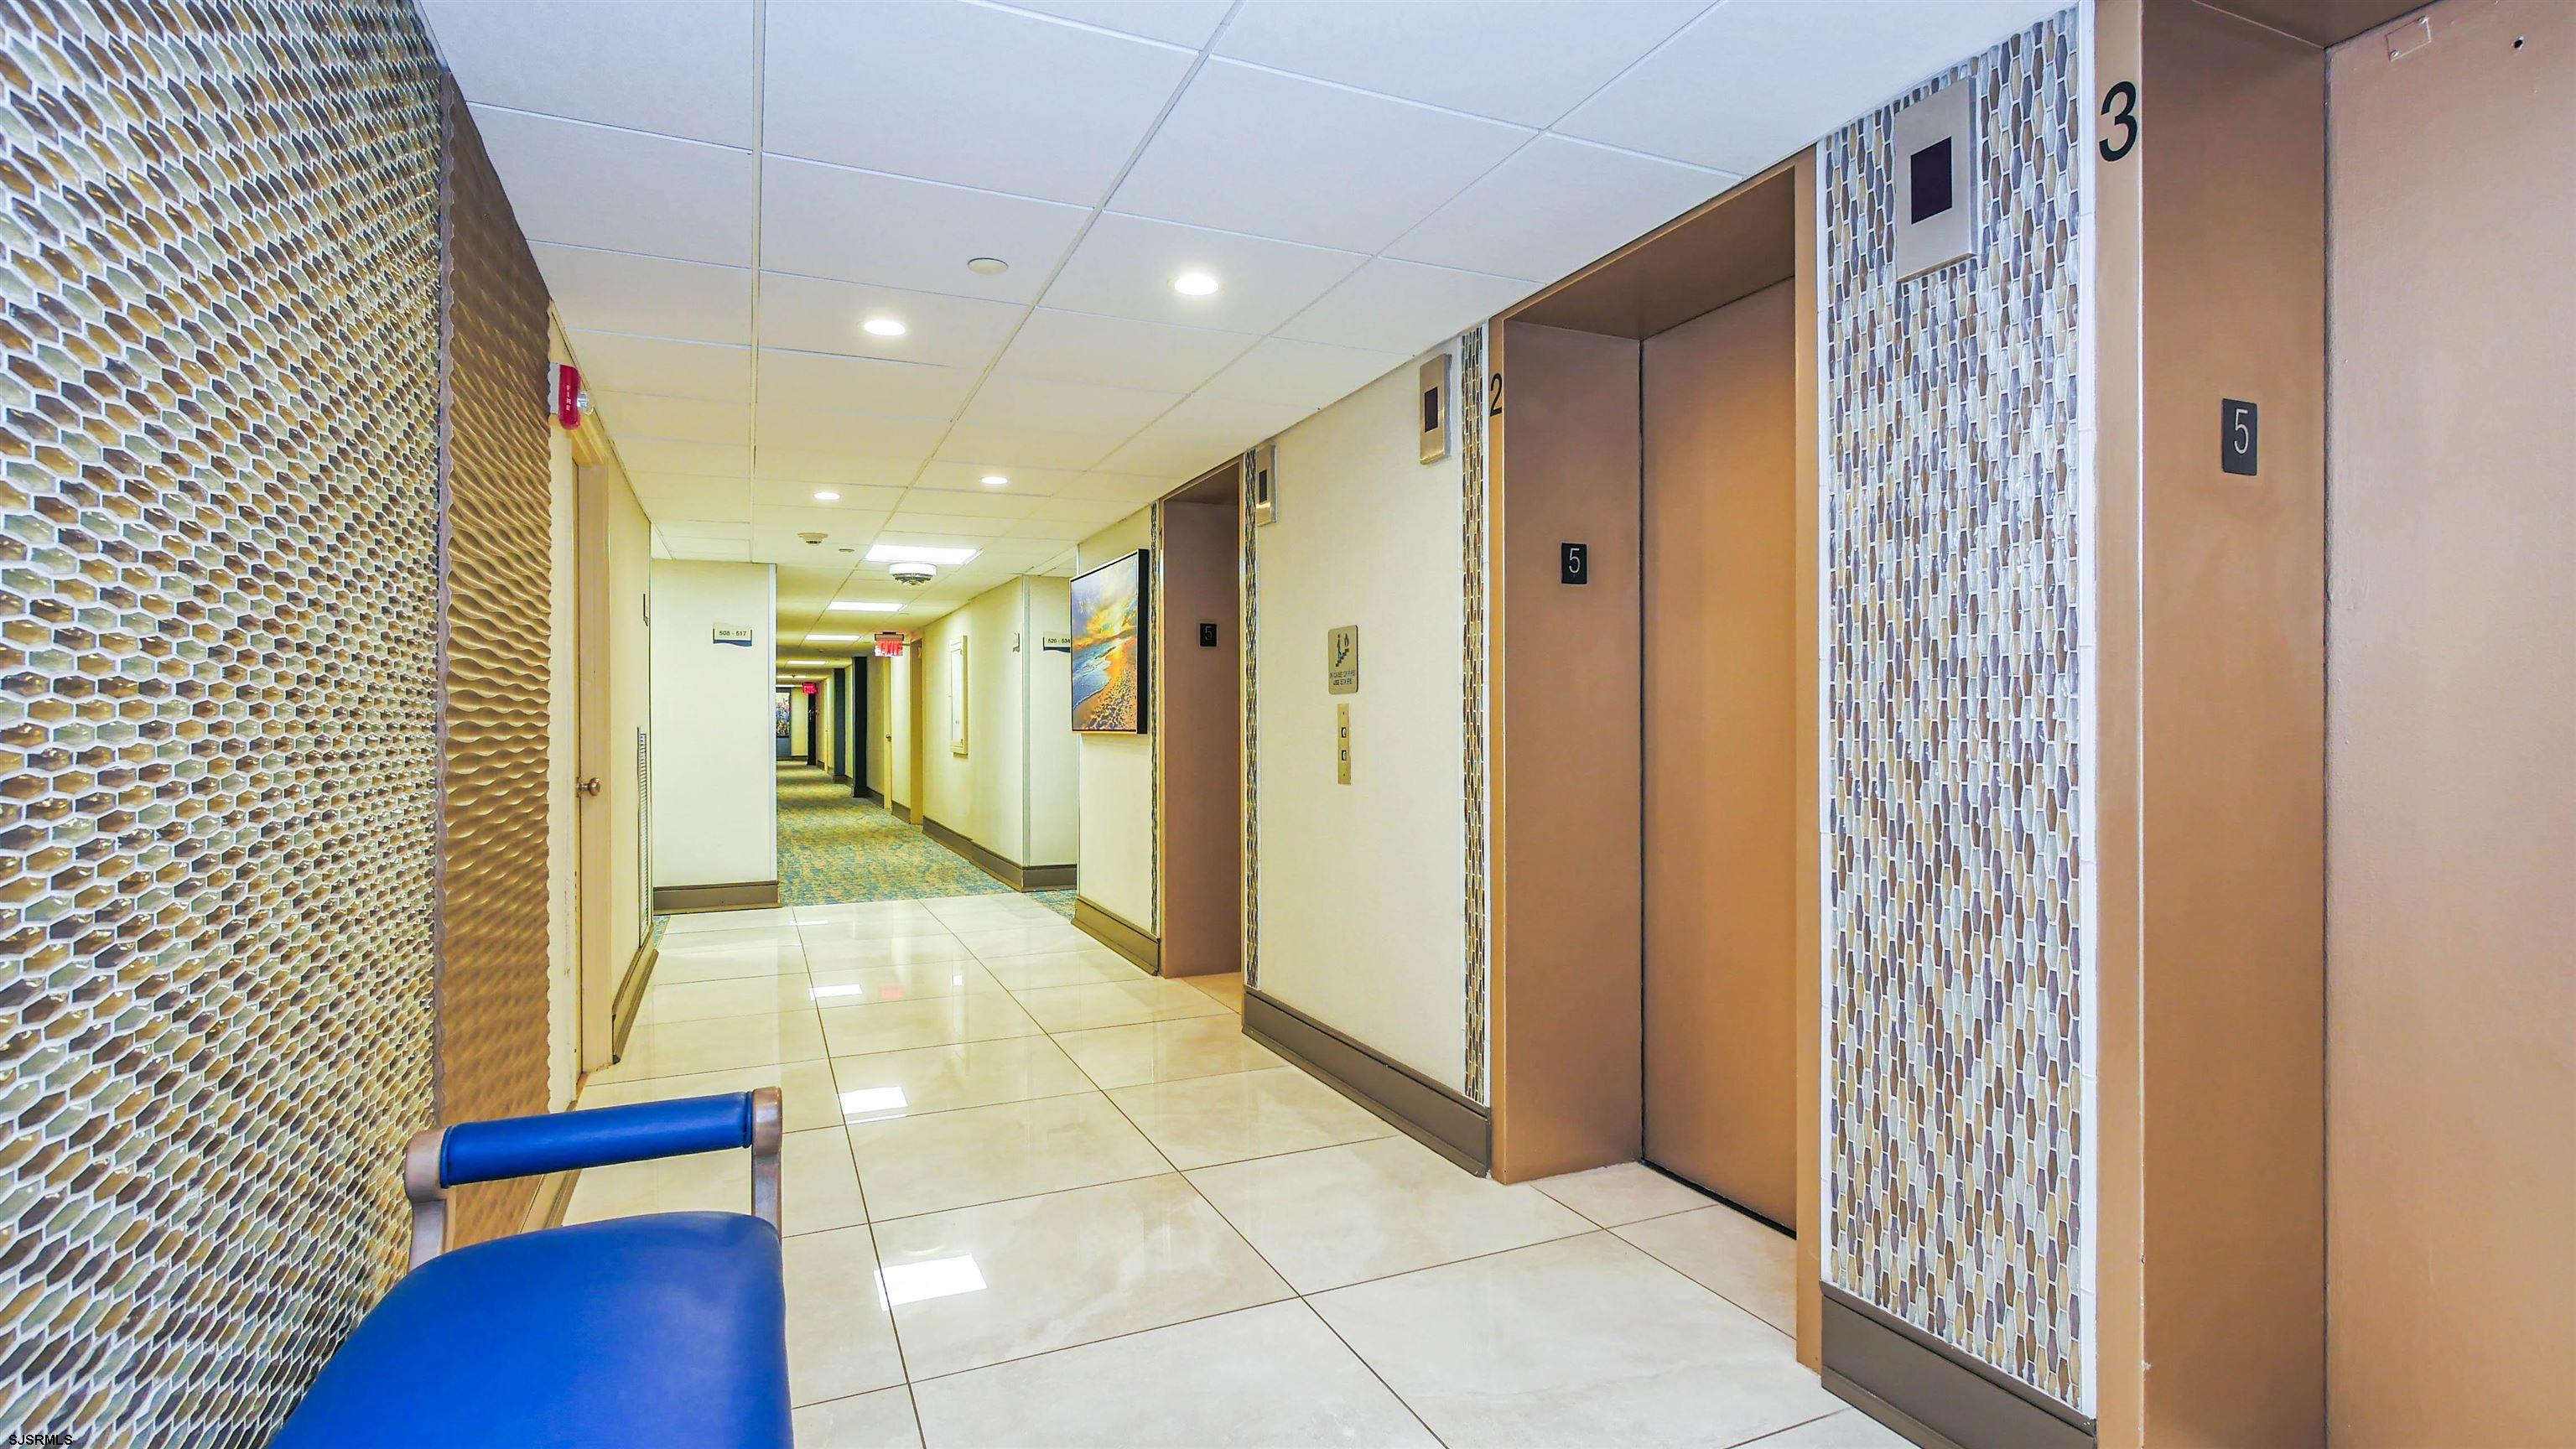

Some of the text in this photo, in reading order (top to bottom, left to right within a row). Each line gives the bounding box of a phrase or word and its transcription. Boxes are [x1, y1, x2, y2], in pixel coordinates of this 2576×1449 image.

[2099, 81, 2137, 162] 3
[1490, 373, 1502, 416] 2
[2234, 408, 2249, 454] 5
[1569, 548, 1581, 574] 5
[1205, 626, 1213, 641] 5
